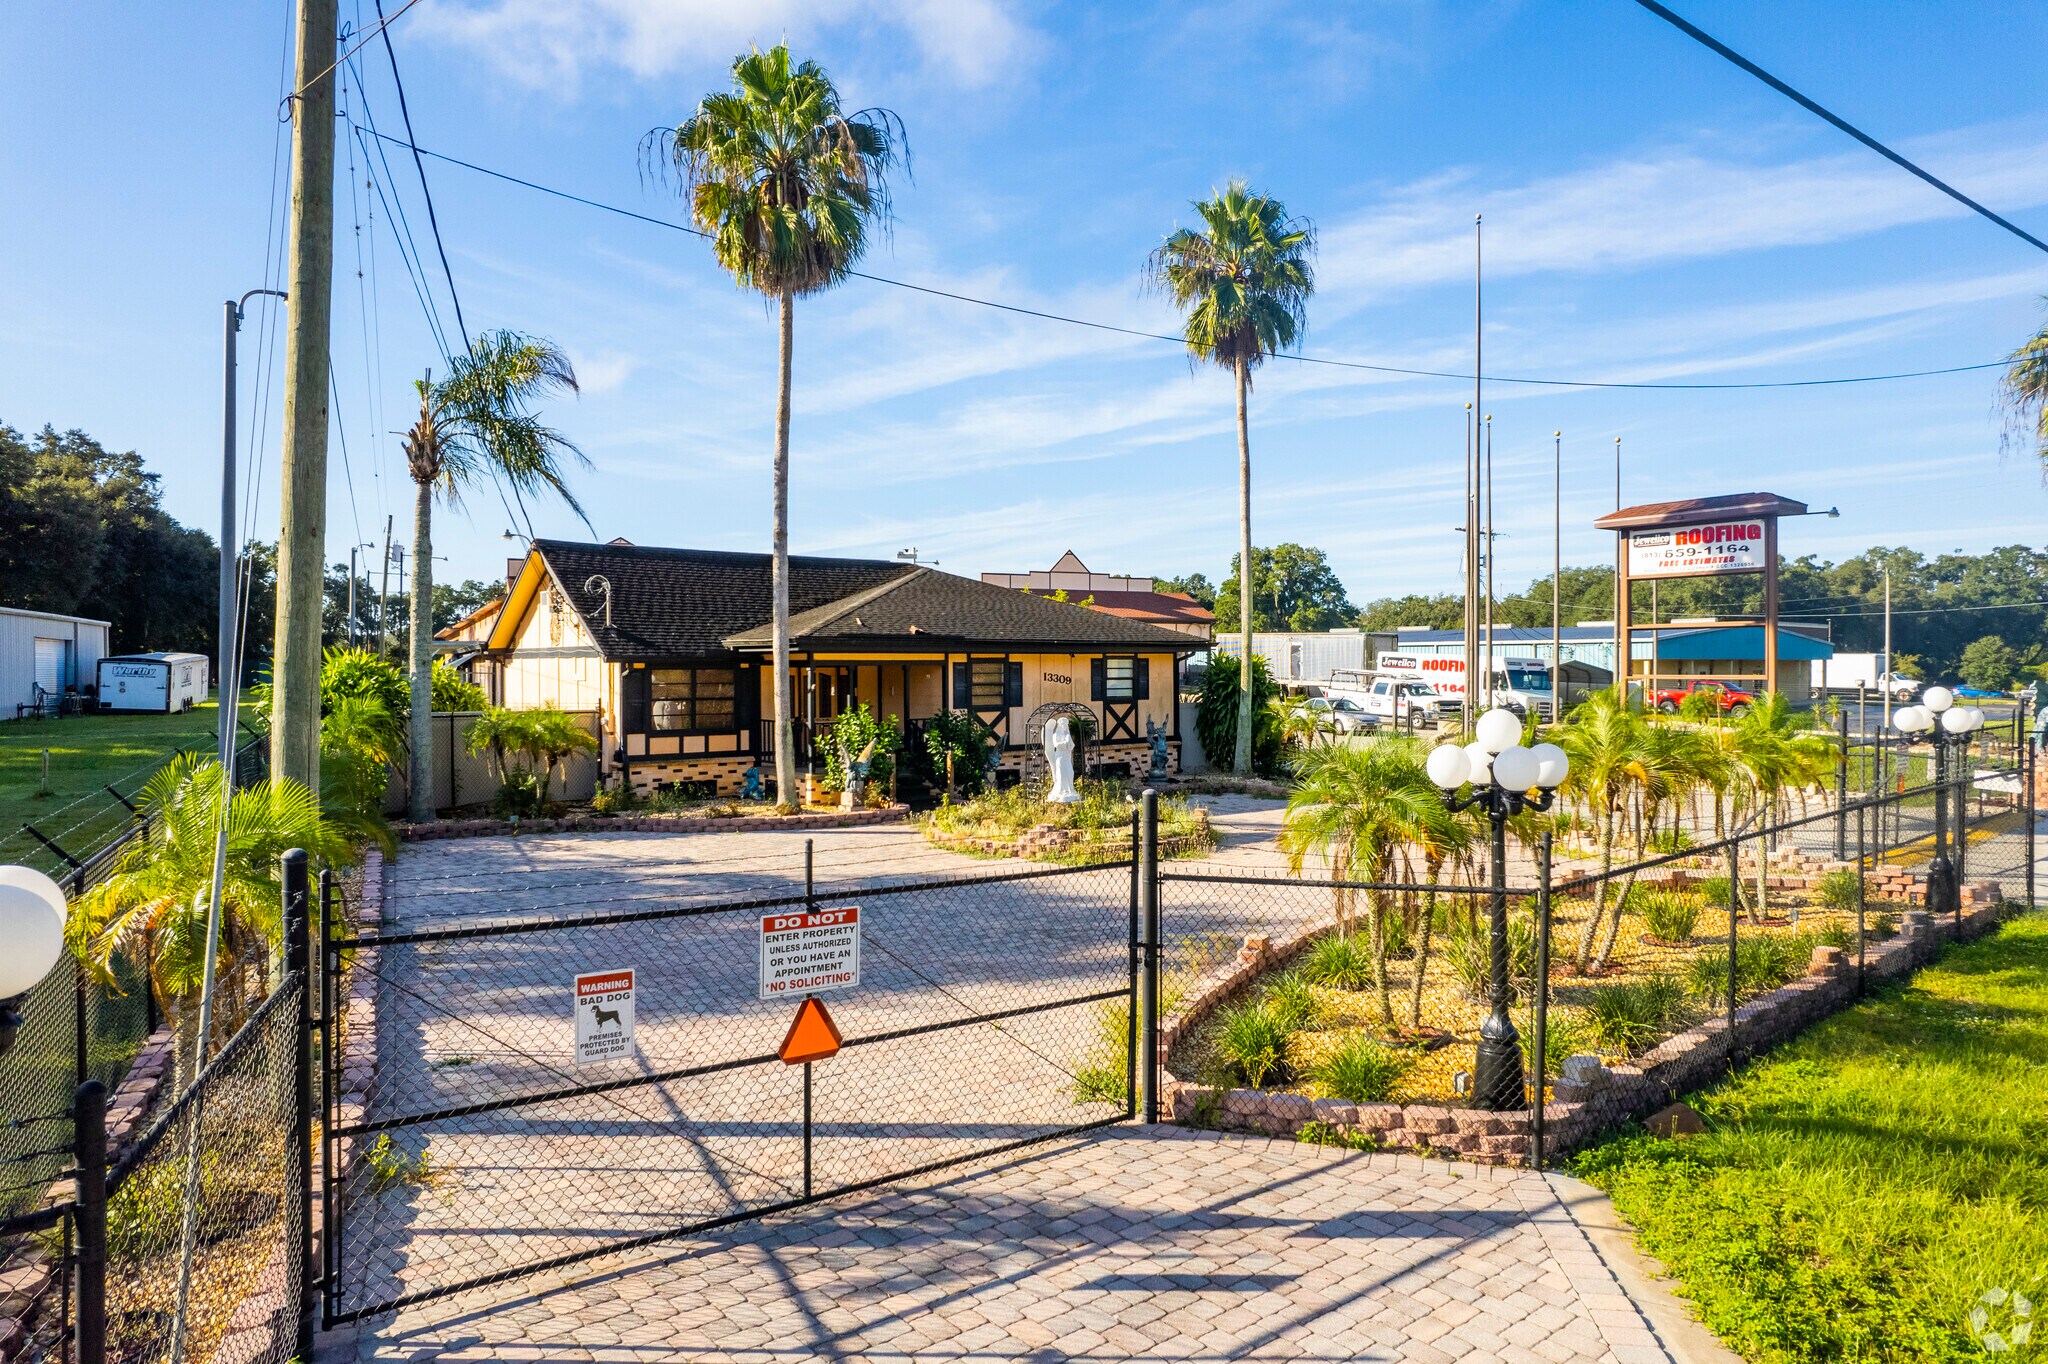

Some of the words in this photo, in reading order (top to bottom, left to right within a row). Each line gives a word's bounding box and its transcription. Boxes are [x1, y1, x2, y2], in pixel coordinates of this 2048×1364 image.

[1675, 524, 1762, 546] ROOFING
[1665, 544, 1750, 558] 659-1164
[1683, 556, 1735, 566] ESTIMATES
[113, 666, 156, 675] Worthy
[1382, 657, 1416, 667] Jewellco
[1422, 660, 1466, 672] ROOFIN
[1043, 672, 1072, 685] 13309
[1432, 683, 1465, 693] 1164
[774, 917, 802, 929] DO
[807, 912, 847, 926] NOT
[765, 932, 799, 943] ENTER
[803, 926, 855, 939] PROPERTY
[769, 944, 800, 954] UNLESS
[802, 937, 851, 950] AUTHORIZED
[770, 958, 784, 967] OR
[787, 955, 807, 964] YOU
[810, 951, 835, 962] HAVE
[838, 949, 851, 958] AN
[774, 962, 843, 978] APPOINTMENT
[581, 979, 629, 993] WARNING
[580, 996, 603, 1006] BAD
[607, 992, 630, 1002] DOG
[589, 1031, 622, 1041] PREMISES
[580, 1038, 620, 1049] PROTECTED
[585, 1048, 608, 1056] GUARD
